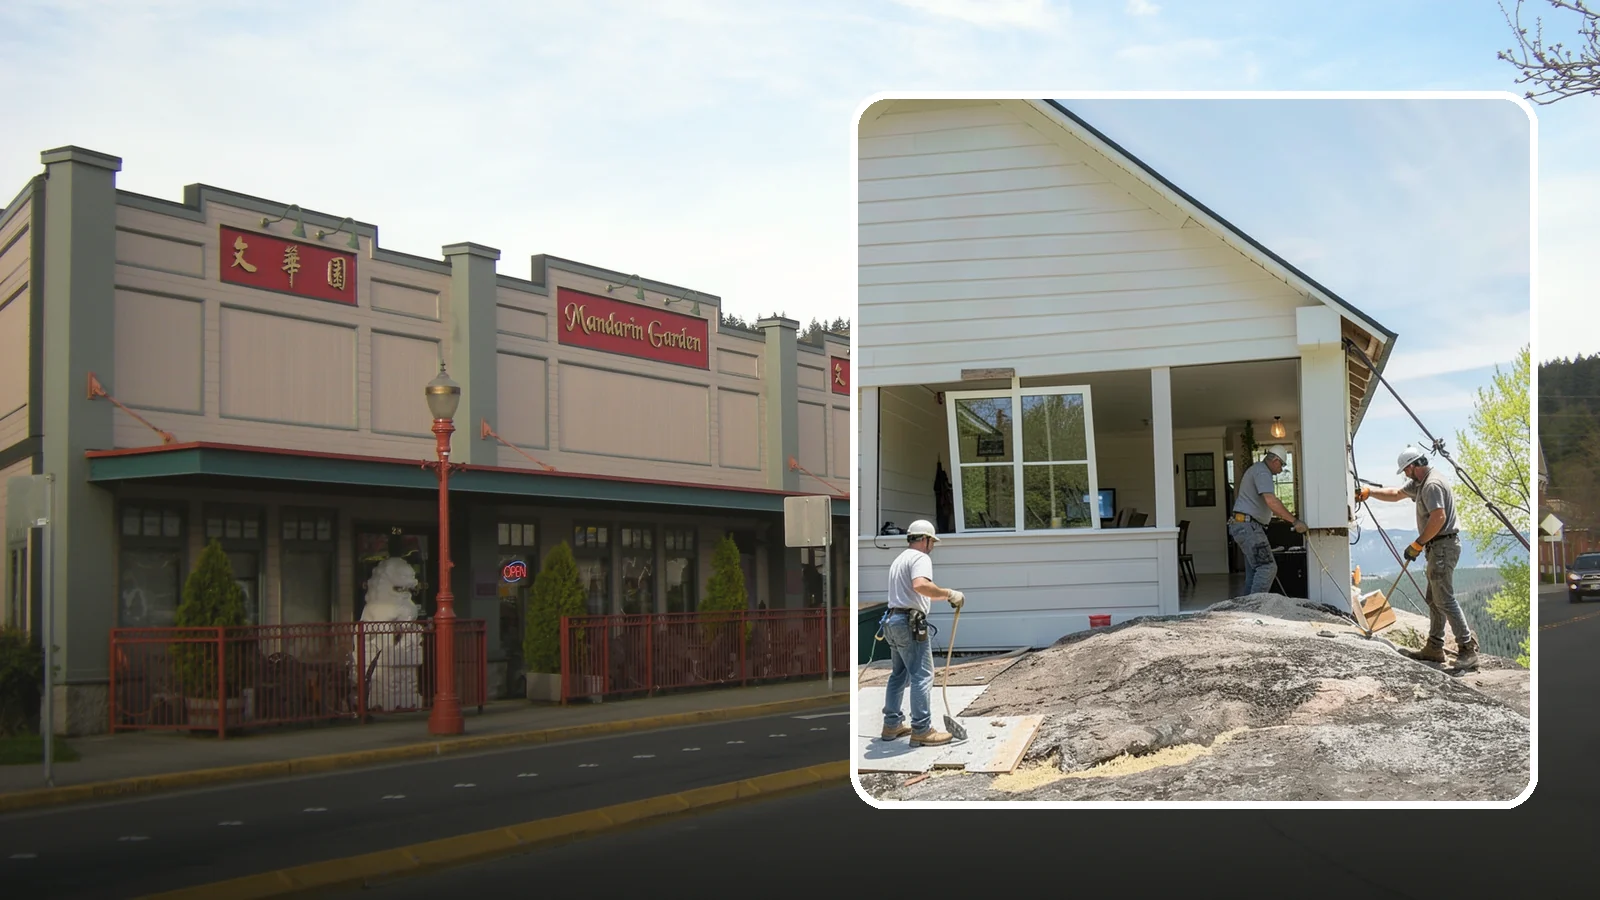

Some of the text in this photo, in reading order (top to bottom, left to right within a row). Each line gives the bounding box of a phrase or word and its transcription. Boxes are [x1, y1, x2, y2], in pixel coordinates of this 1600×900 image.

[231, 236, 346, 291] 文華園
[565, 302, 702, 352] Mandarin Garden
[834, 363, 847, 387] 文
[503, 565, 527, 578] OPEN
